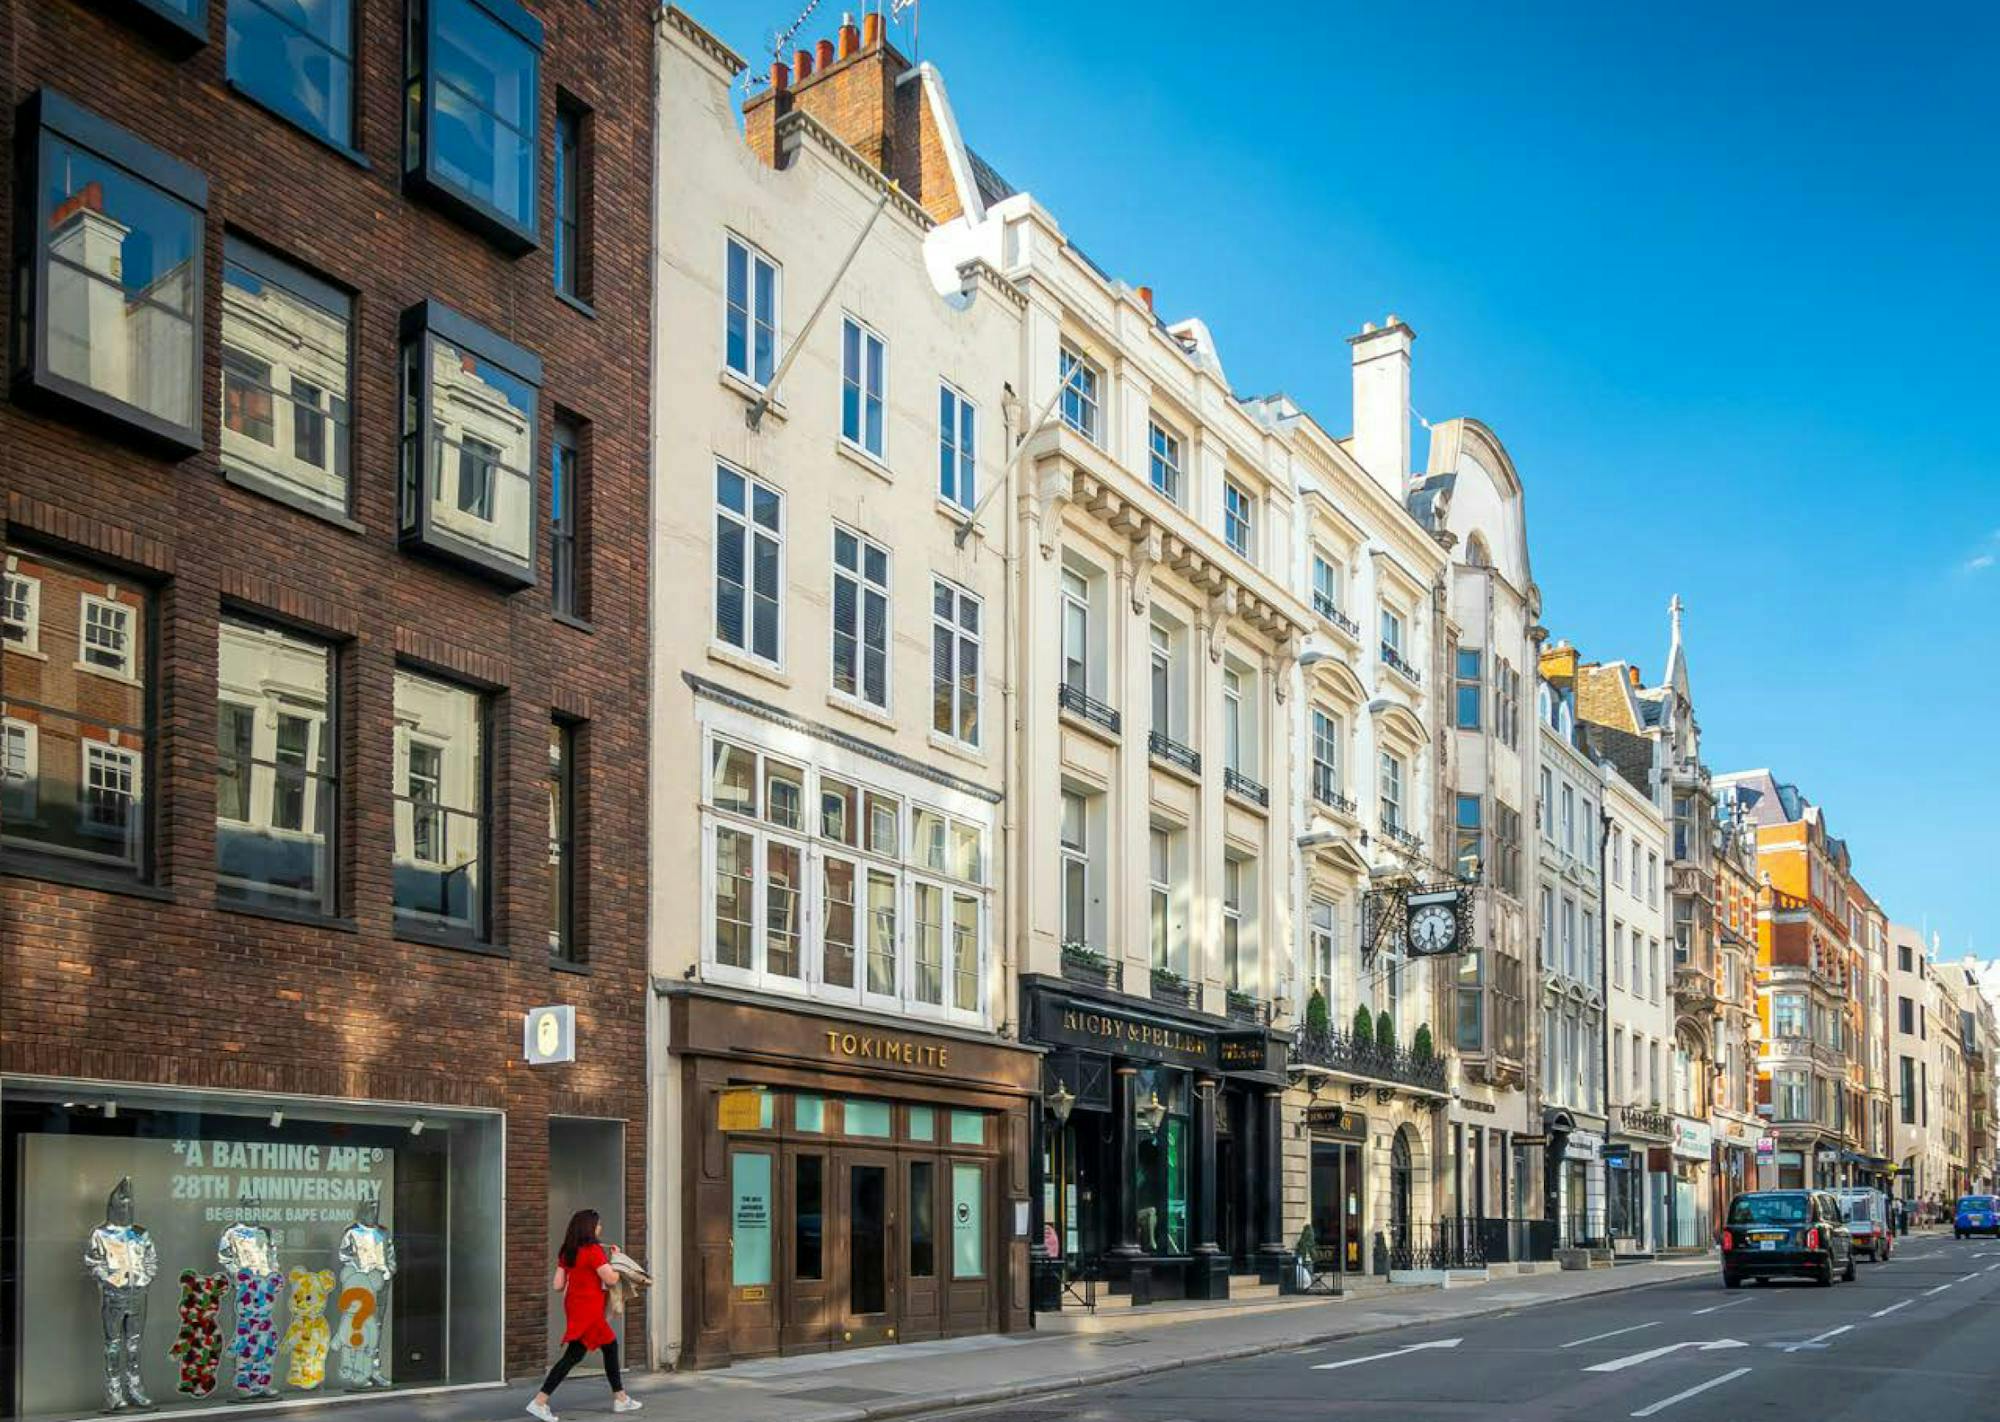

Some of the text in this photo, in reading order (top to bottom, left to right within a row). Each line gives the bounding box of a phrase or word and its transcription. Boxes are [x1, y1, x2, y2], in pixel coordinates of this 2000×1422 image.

[1063, 1010, 1124, 1040] RIGBY
[1127, 1023, 1141, 1042] &
[212, 1142, 320, 1171] BATHING
[172, 1174, 383, 1201] 28TH ANNIVERSARY
[205, 1207, 354, 1222] BE@RBRICK BAPE CAMO
